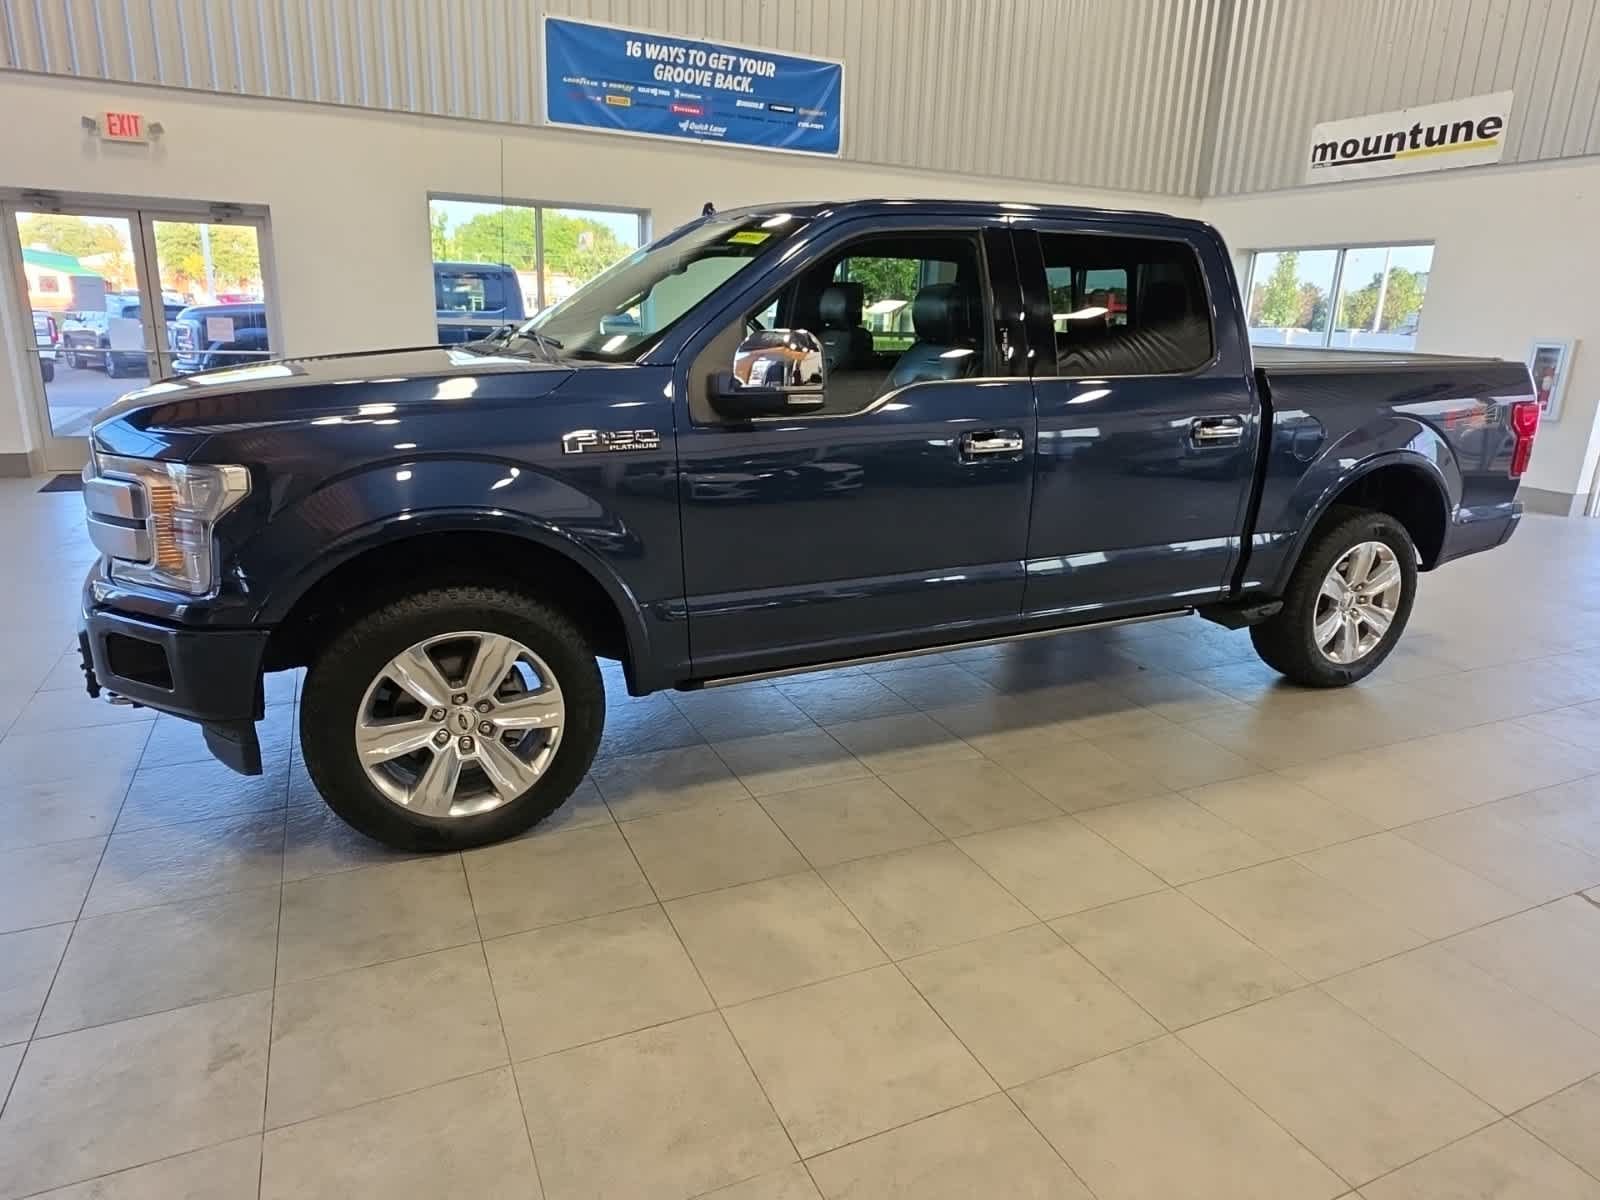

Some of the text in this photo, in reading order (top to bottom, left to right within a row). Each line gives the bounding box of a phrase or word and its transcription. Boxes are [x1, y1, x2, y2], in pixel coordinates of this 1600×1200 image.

[626, 40, 776, 78] 16 WAYS TO GET YOUR
[653, 63, 713, 87] GROOVE
[714, 71, 754, 93] BACK.
[107, 112, 139, 137] EXIT
[1312, 115, 1503, 163] mountune
